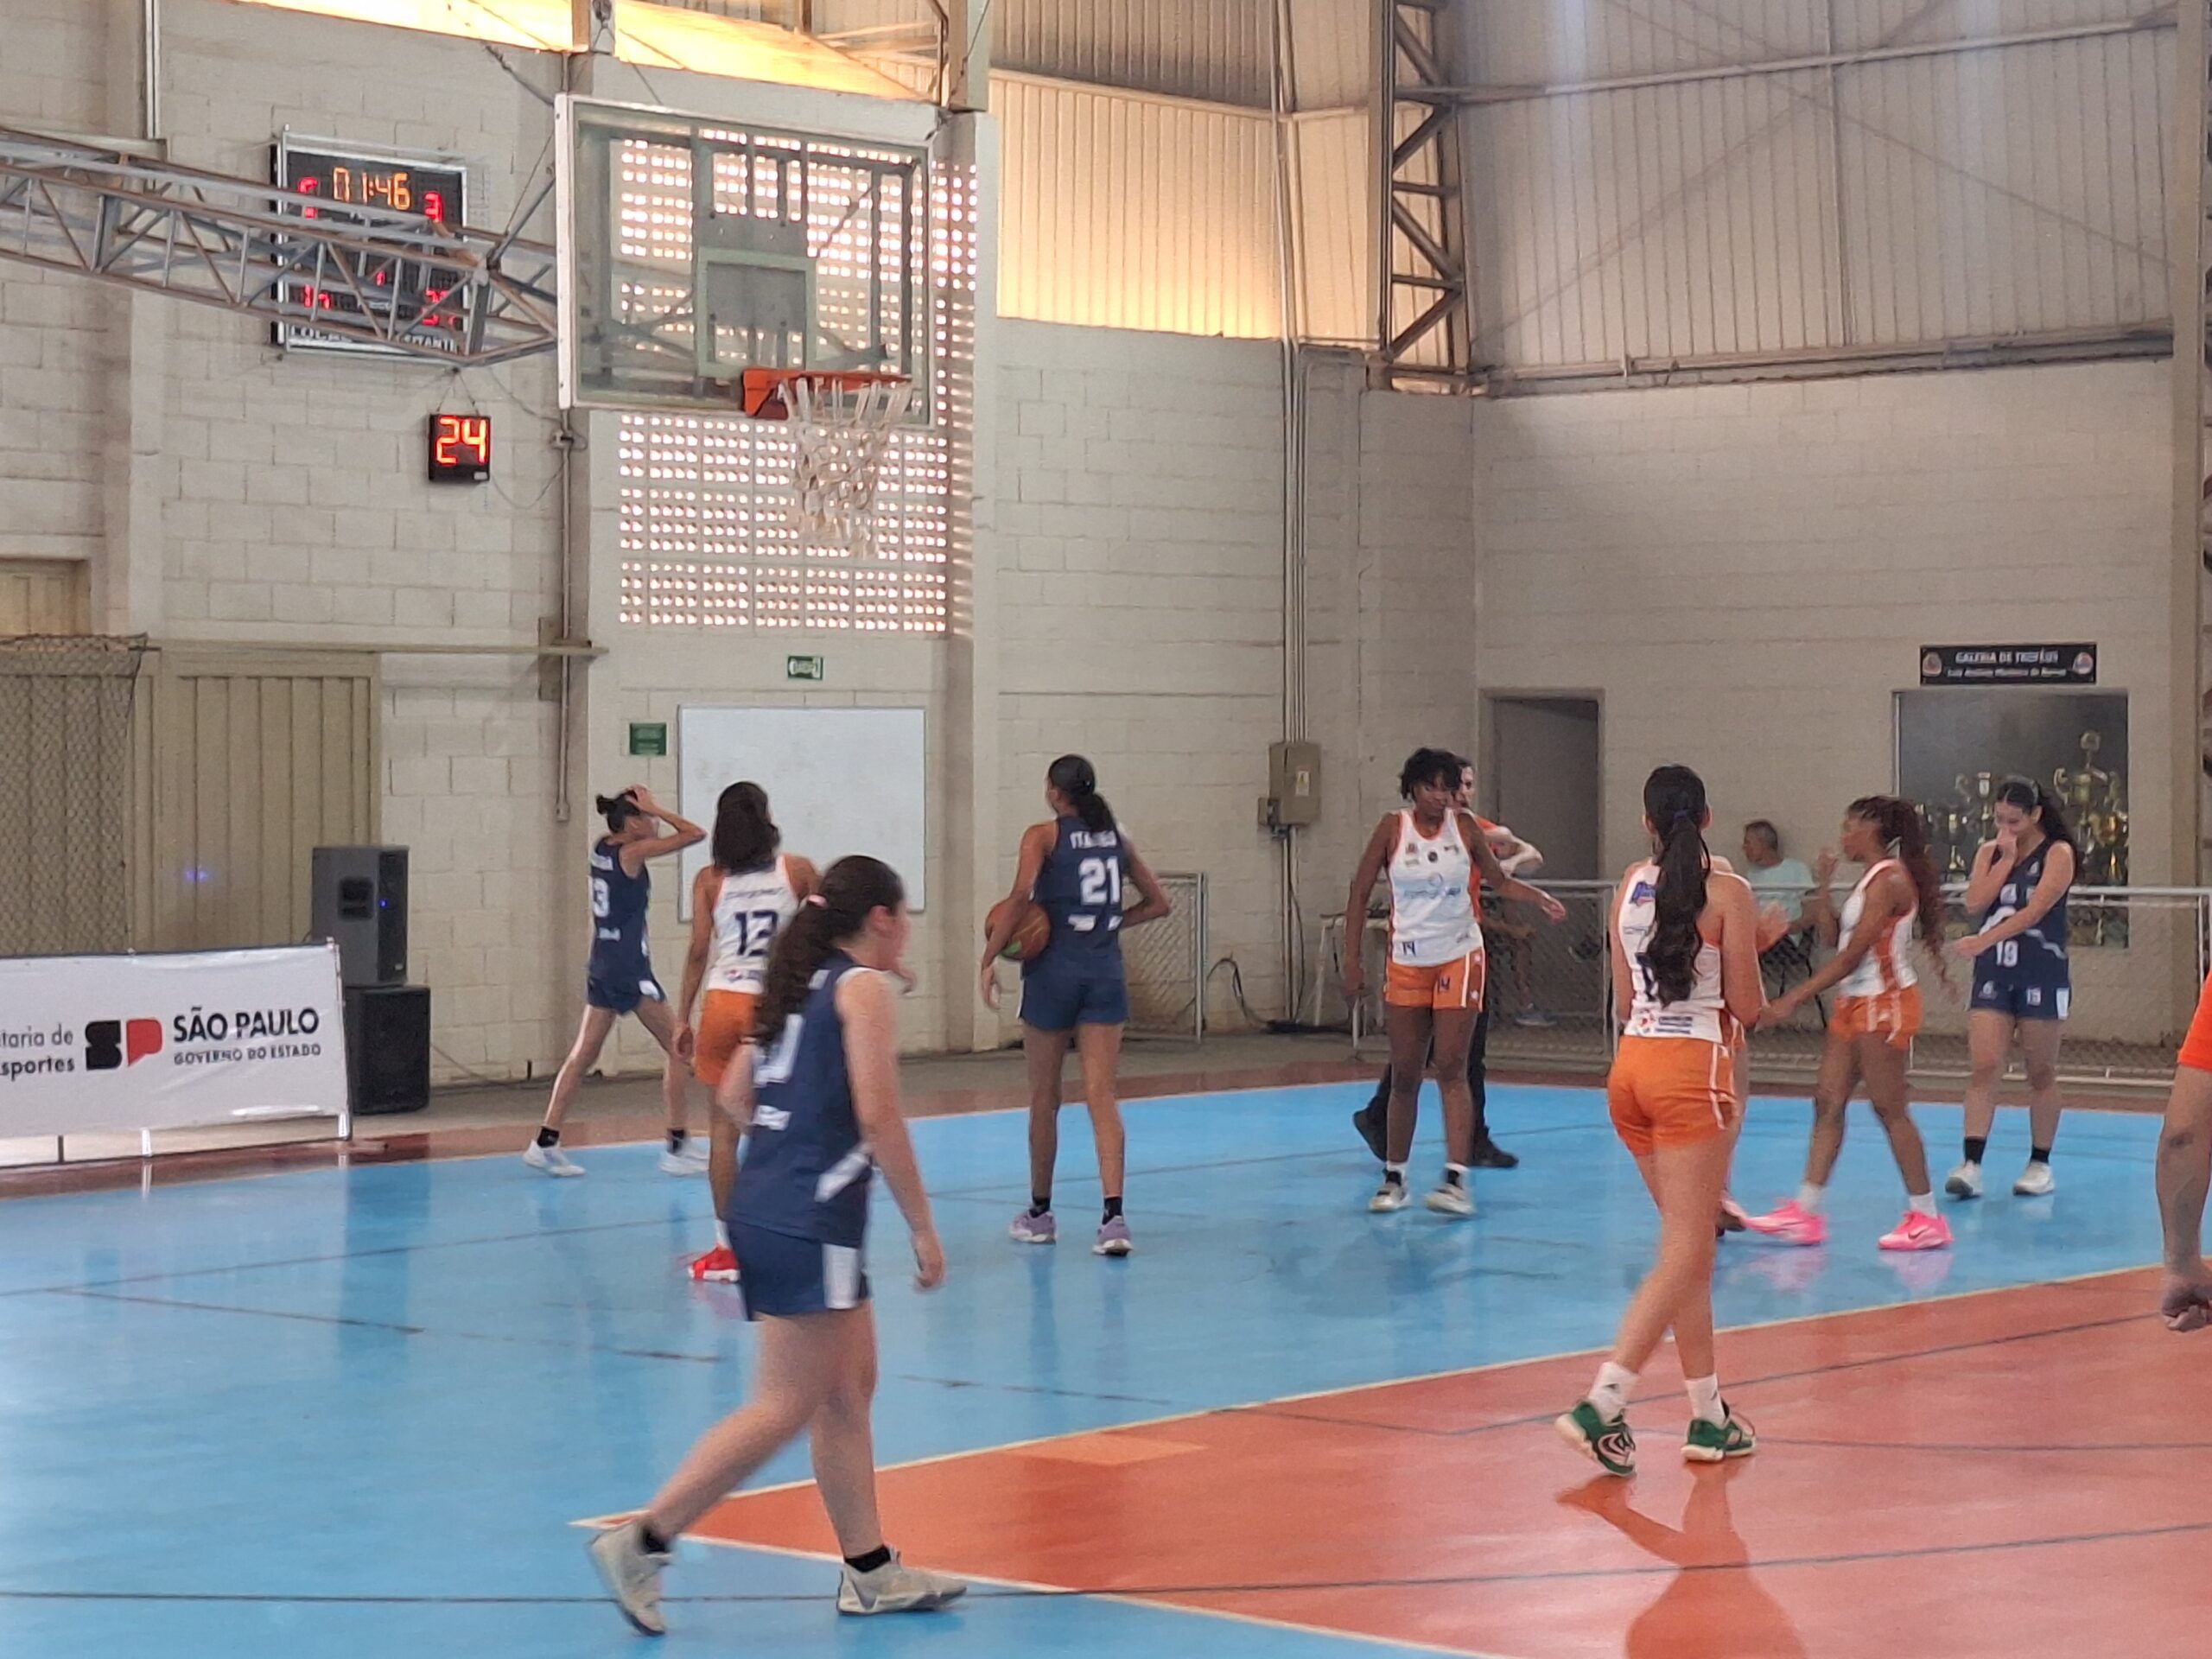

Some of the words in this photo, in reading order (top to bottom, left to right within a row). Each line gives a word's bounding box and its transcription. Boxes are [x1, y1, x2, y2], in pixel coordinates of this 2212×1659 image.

[435, 416, 487, 466] 24
[1078, 856, 1122, 906] 21
[51, 1023, 73, 1046] de
[173, 1005, 228, 1043] SÃO
[235, 1007, 320, 1040] PAULO
[174, 1048, 243, 1065] GOVERNO
[246, 1046, 267, 1061] DO
[270, 1043, 321, 1059] ESTADO
